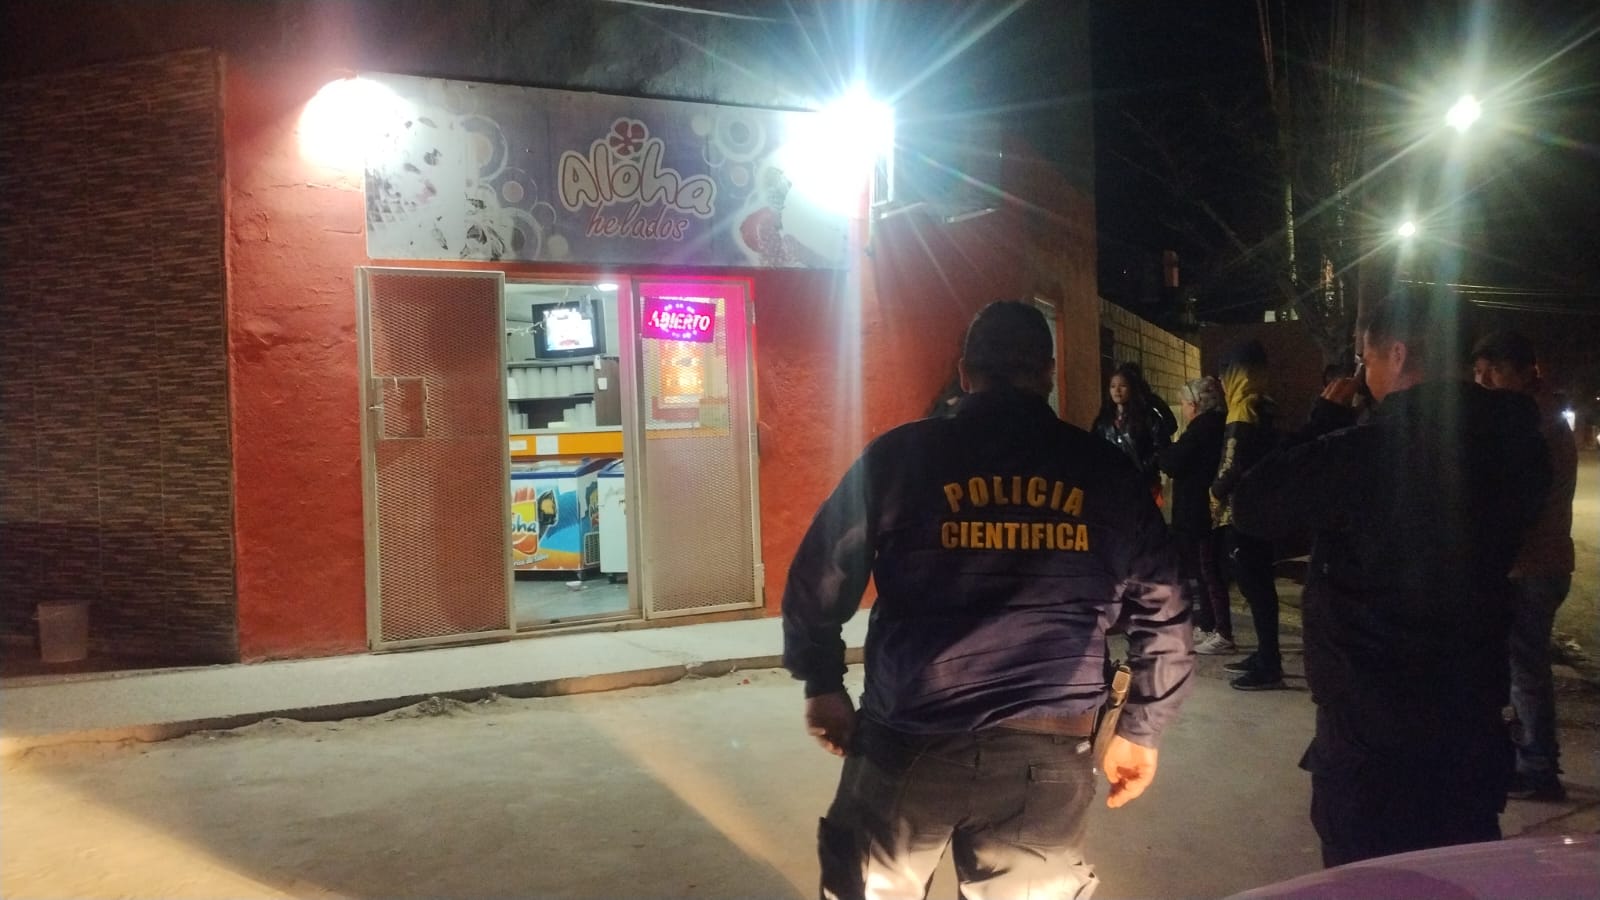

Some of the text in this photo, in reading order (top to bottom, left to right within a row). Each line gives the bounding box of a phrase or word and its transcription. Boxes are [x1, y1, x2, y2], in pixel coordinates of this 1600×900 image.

[561, 142, 714, 214] Aloha
[586, 202, 688, 240] helados
[648, 309, 711, 332] ABIERTO
[943, 475, 1085, 517] POLICIA
[941, 521, 1089, 552] CIENTIFICA
